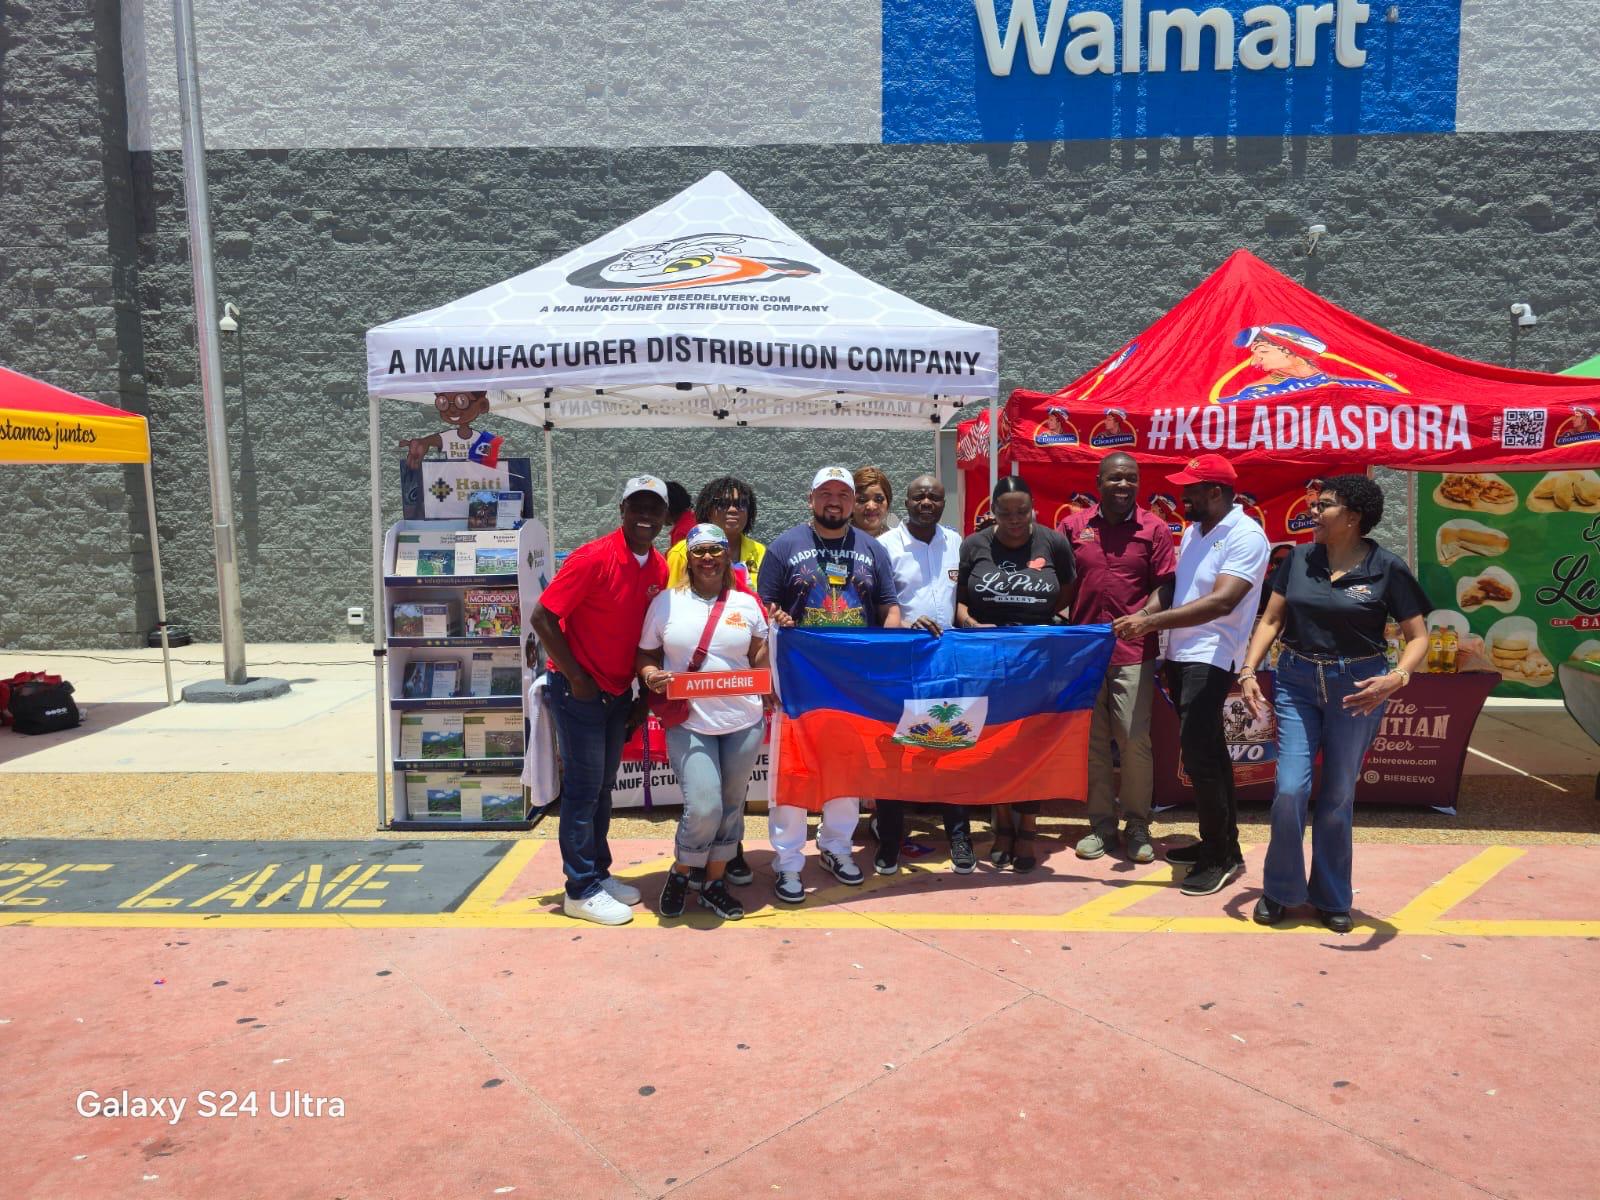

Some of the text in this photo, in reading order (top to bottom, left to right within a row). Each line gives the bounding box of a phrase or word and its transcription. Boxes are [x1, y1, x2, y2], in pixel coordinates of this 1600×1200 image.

[977, 0, 1369, 76] Walmart
[583, 293, 791, 303] WWW.HONEYBEEDELIVERY.COM
[539, 302, 829, 313] A MANUFACTURER DISTRIBUTION COMPANY
[388, 335, 980, 376] A MANUFACTURER DISTRIBUTION COMPANY
[53, 422, 97, 450] juntos
[1147, 404, 1472, 451] #KOLADIASPORA
[456, 477, 502, 490] Haiti
[789, 548, 827, 566] HAPPY
[974, 572, 1055, 596] La Paix
[468, 594, 516, 603] MONOPOLY
[685, 676, 754, 691] AYITI CHÉRIE
[1384, 698, 1418, 715] The
[1372, 737, 1415, 752] Beer
[1383, 774, 1436, 784] BIEREEWO
[117, 864, 424, 909] LANE
